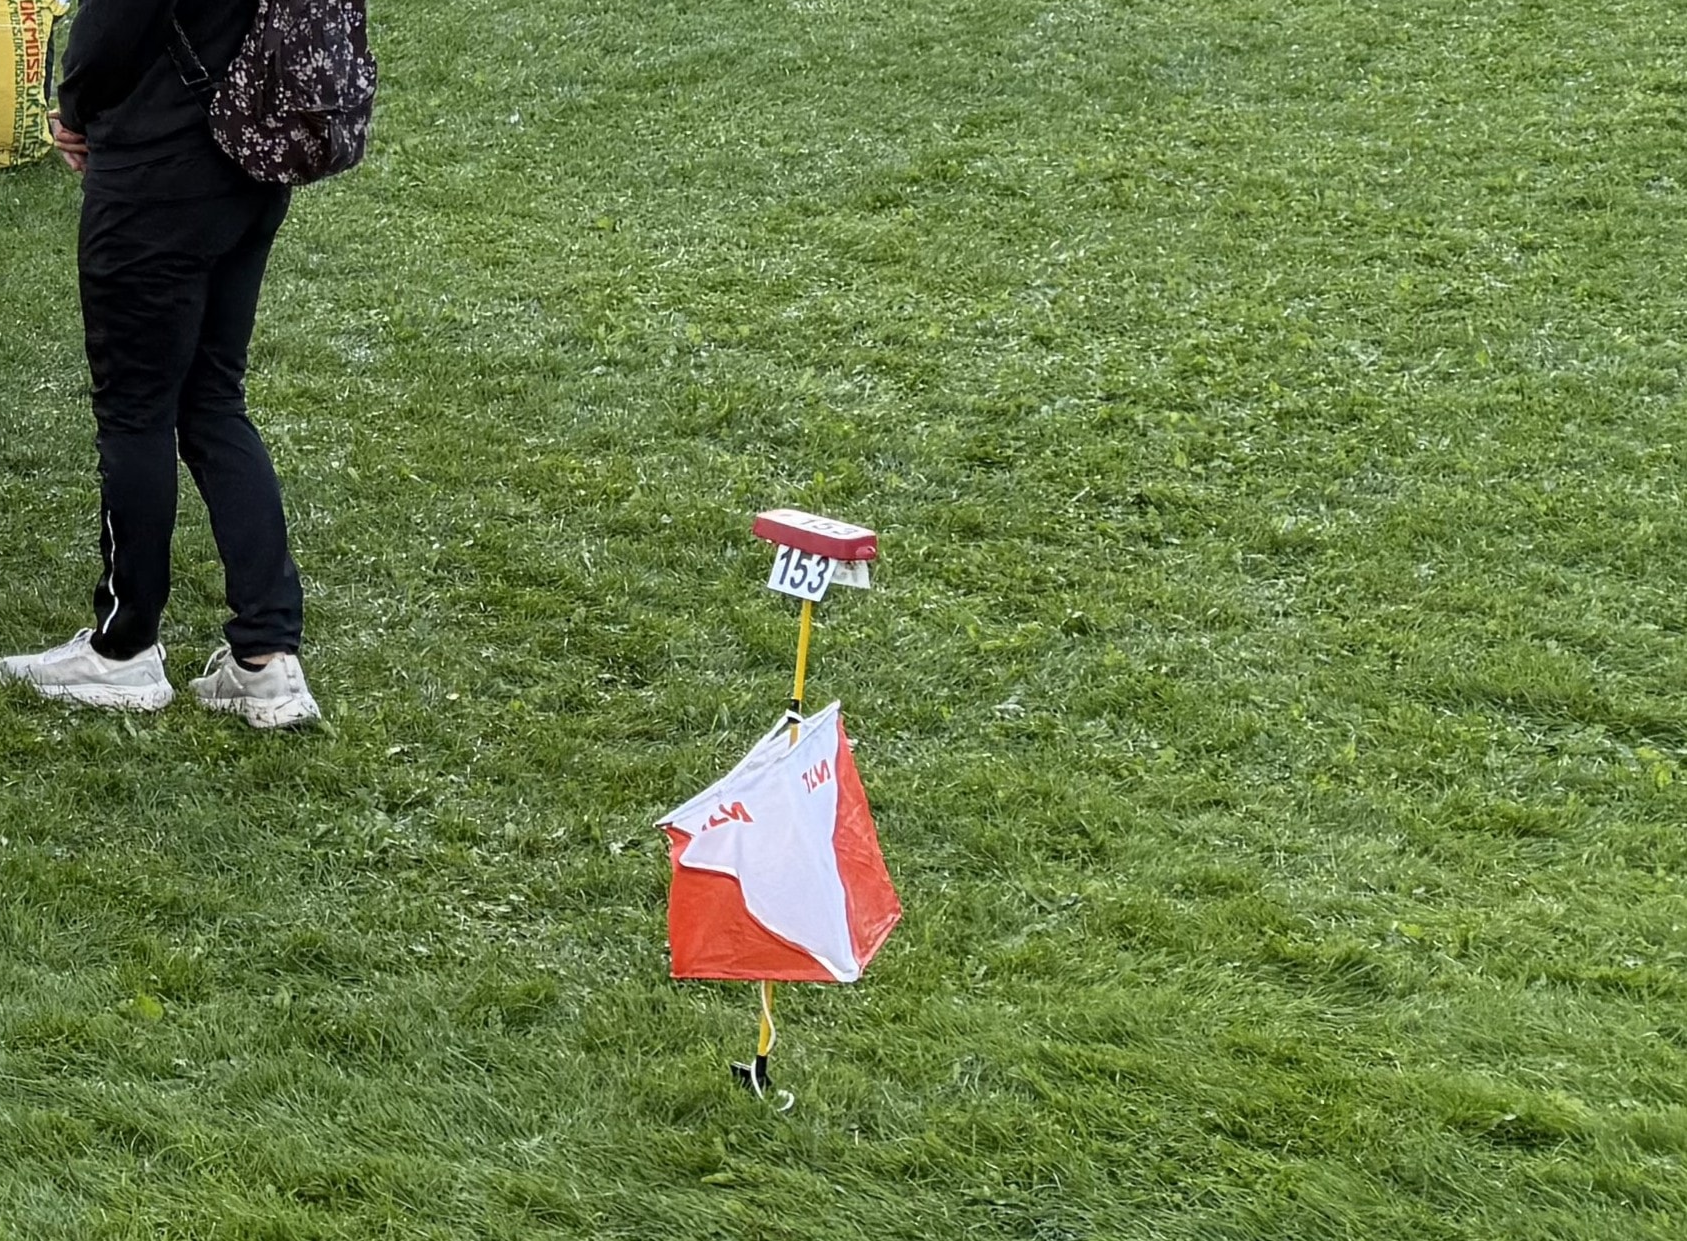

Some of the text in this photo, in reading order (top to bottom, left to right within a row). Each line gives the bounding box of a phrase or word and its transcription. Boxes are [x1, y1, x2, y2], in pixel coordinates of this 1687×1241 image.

[20, 0, 36, 25] OK
[24, 28, 40, 83] MOSS
[778, 546, 831, 594] 153
